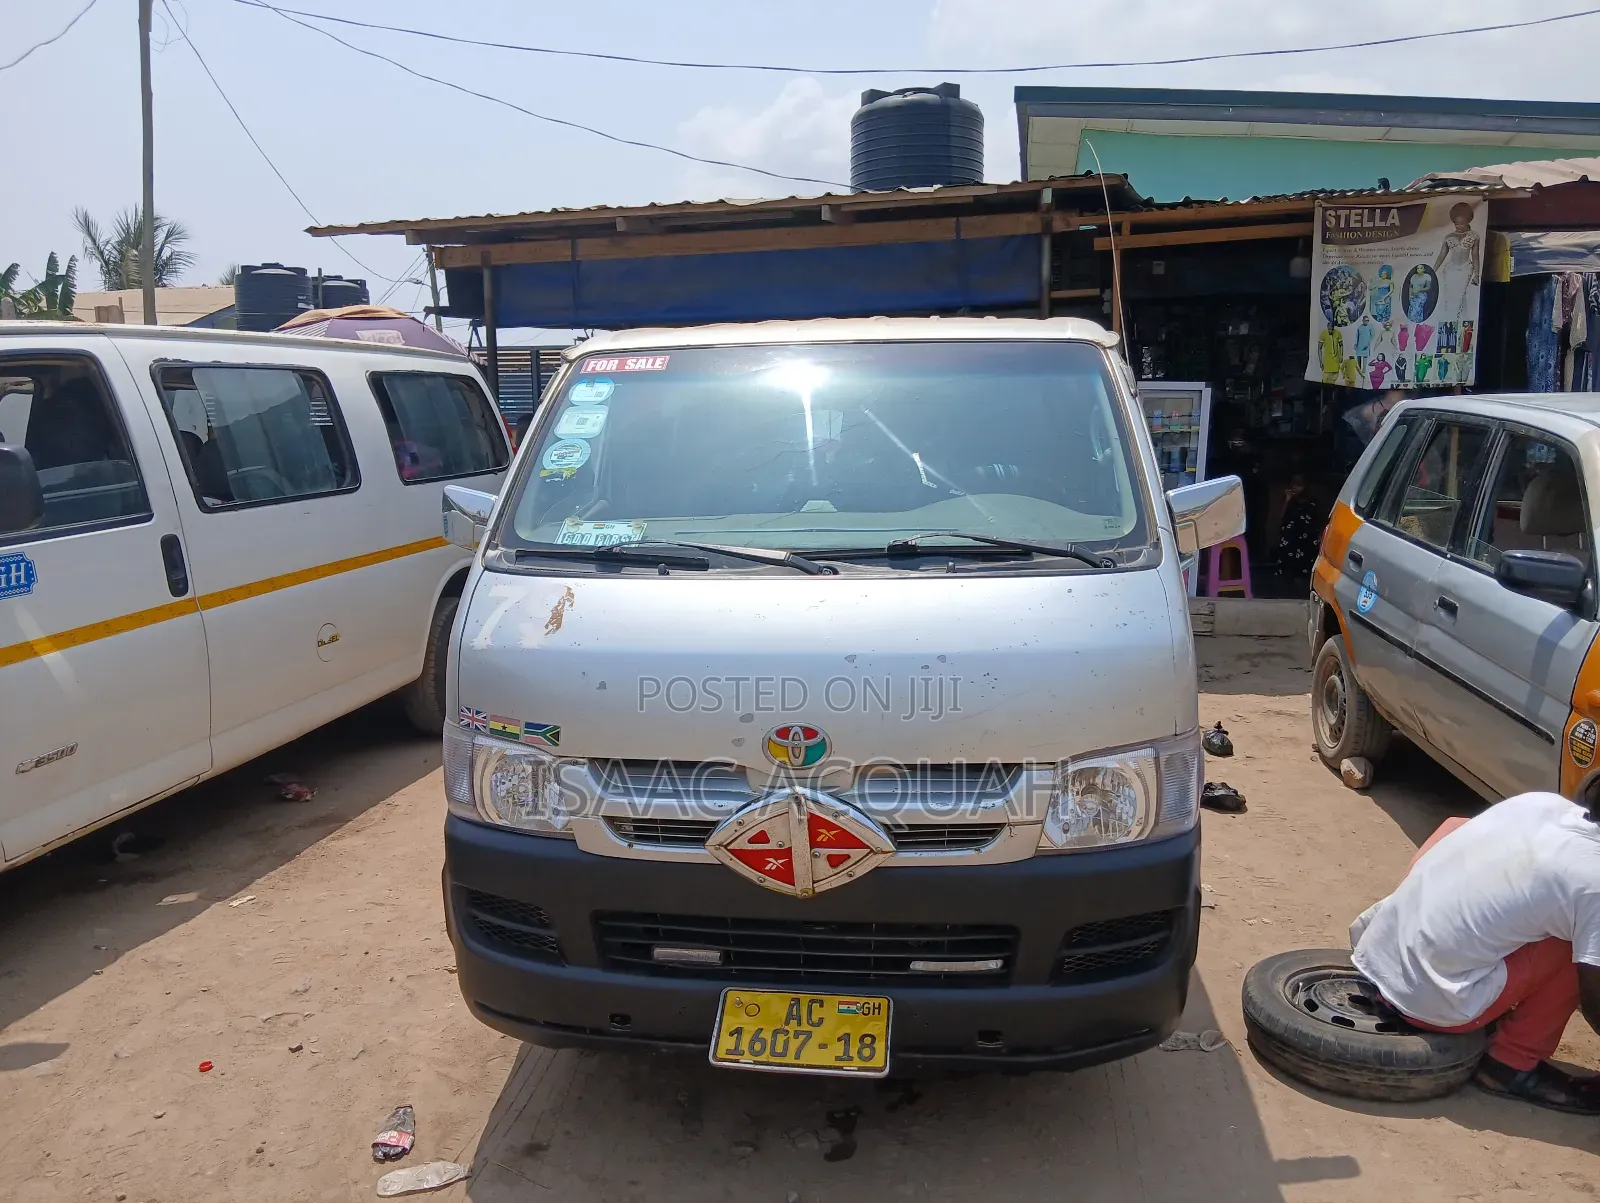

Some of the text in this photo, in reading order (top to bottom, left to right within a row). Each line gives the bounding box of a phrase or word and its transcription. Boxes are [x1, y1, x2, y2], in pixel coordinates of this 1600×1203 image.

[1325, 208, 1400, 228] STELLA
[1325, 230, 1400, 239] FASHION DESIGN
[585, 357, 666, 371] FOR SALE
[562, 532, 641, 547] GOD FIRST
[35, 742, 78, 768] 3500
[785, 997, 882, 1028] AC GH
